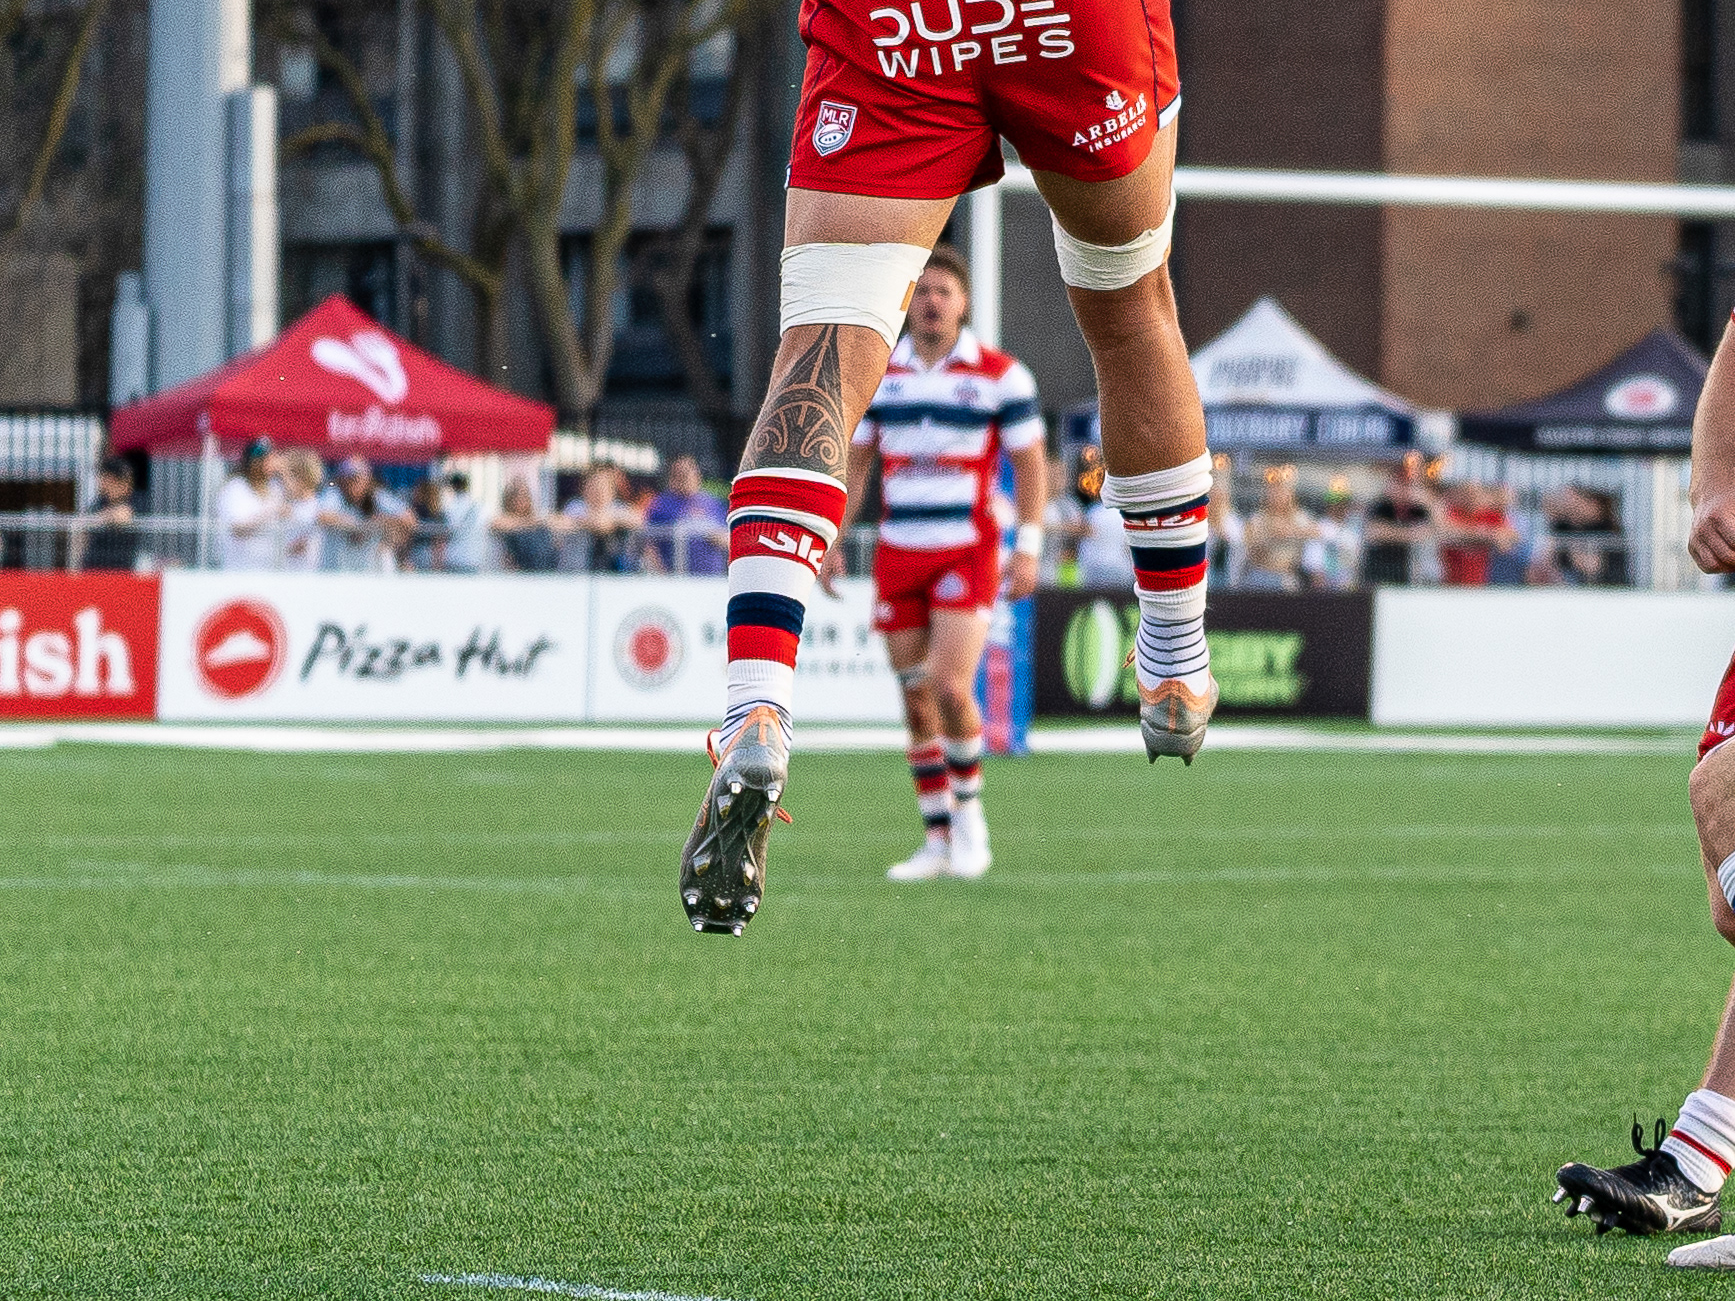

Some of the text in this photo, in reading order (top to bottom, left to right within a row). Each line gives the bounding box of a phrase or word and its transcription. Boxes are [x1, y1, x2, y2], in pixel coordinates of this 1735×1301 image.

[877, 29, 1075, 78] WIPES
[822, 108, 849, 127] MLR
[0, 608, 136, 696] ish
[299, 619, 557, 684] Pizza Hut
